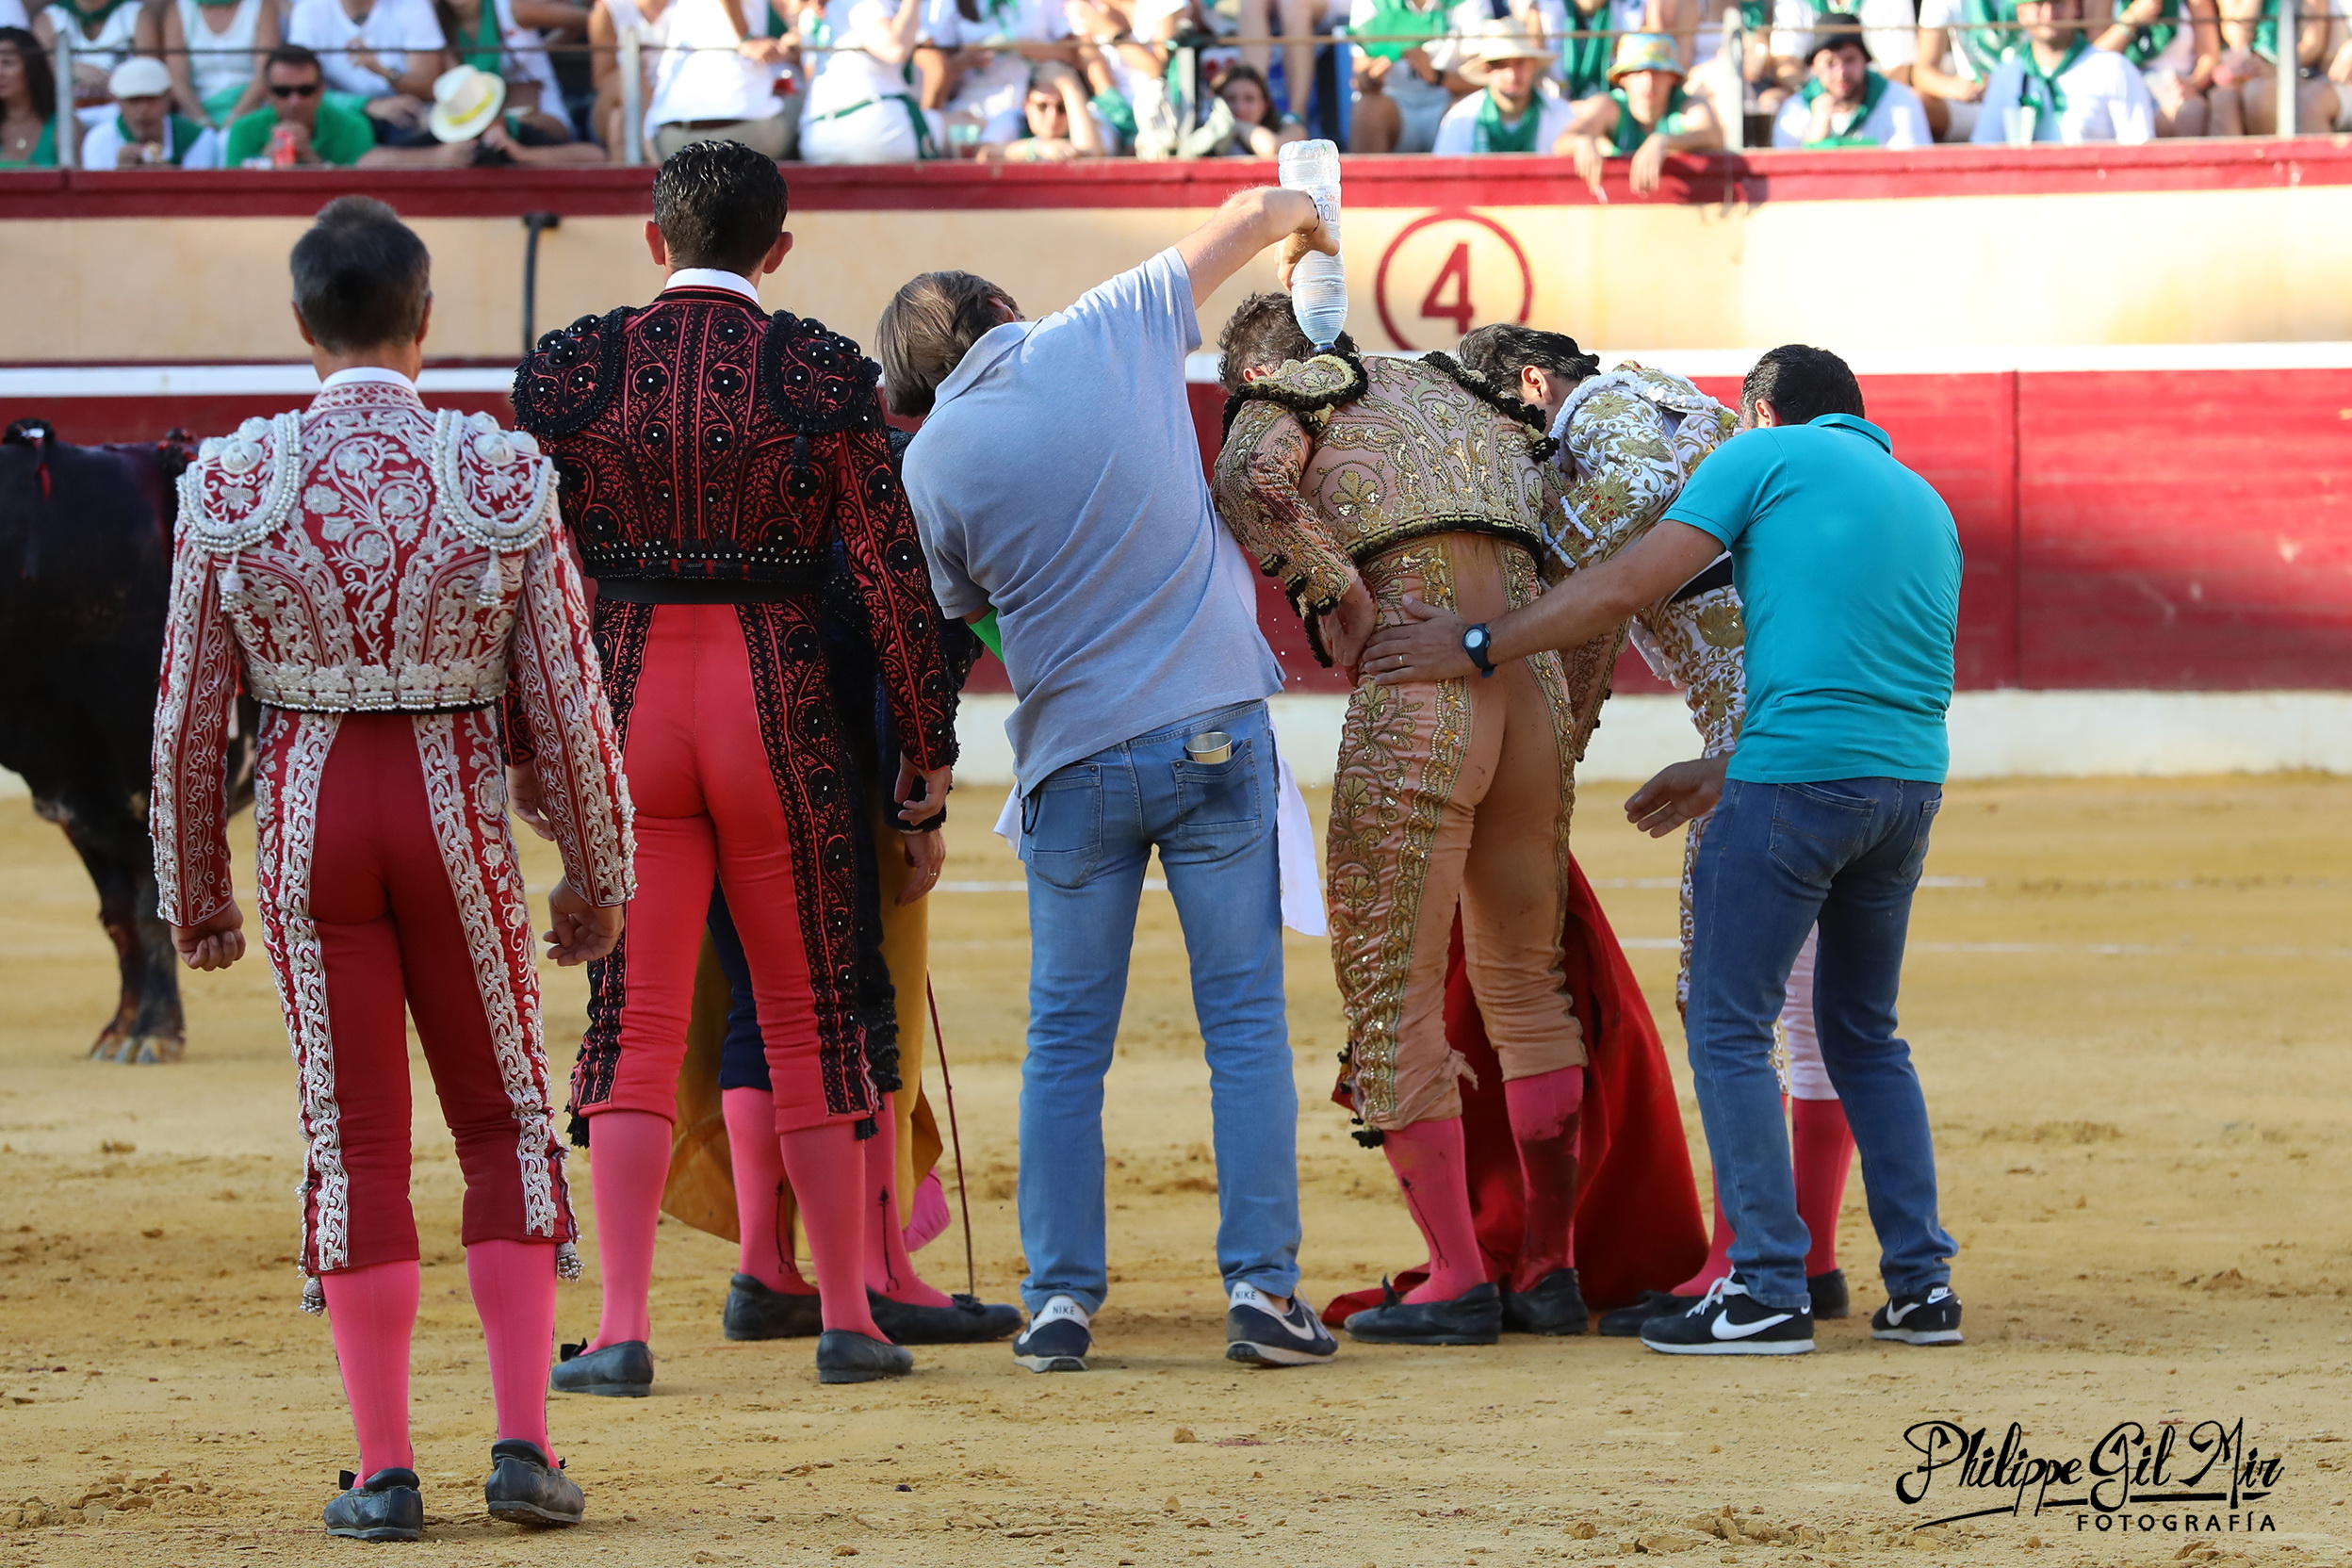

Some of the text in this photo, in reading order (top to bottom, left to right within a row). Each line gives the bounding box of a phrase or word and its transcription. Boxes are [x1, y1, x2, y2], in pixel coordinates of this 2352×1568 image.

[1421, 242, 1474, 335] 4
[1234, 1291, 1256, 1300] NIKE
[1053, 1306, 1075, 1315] NIKE
